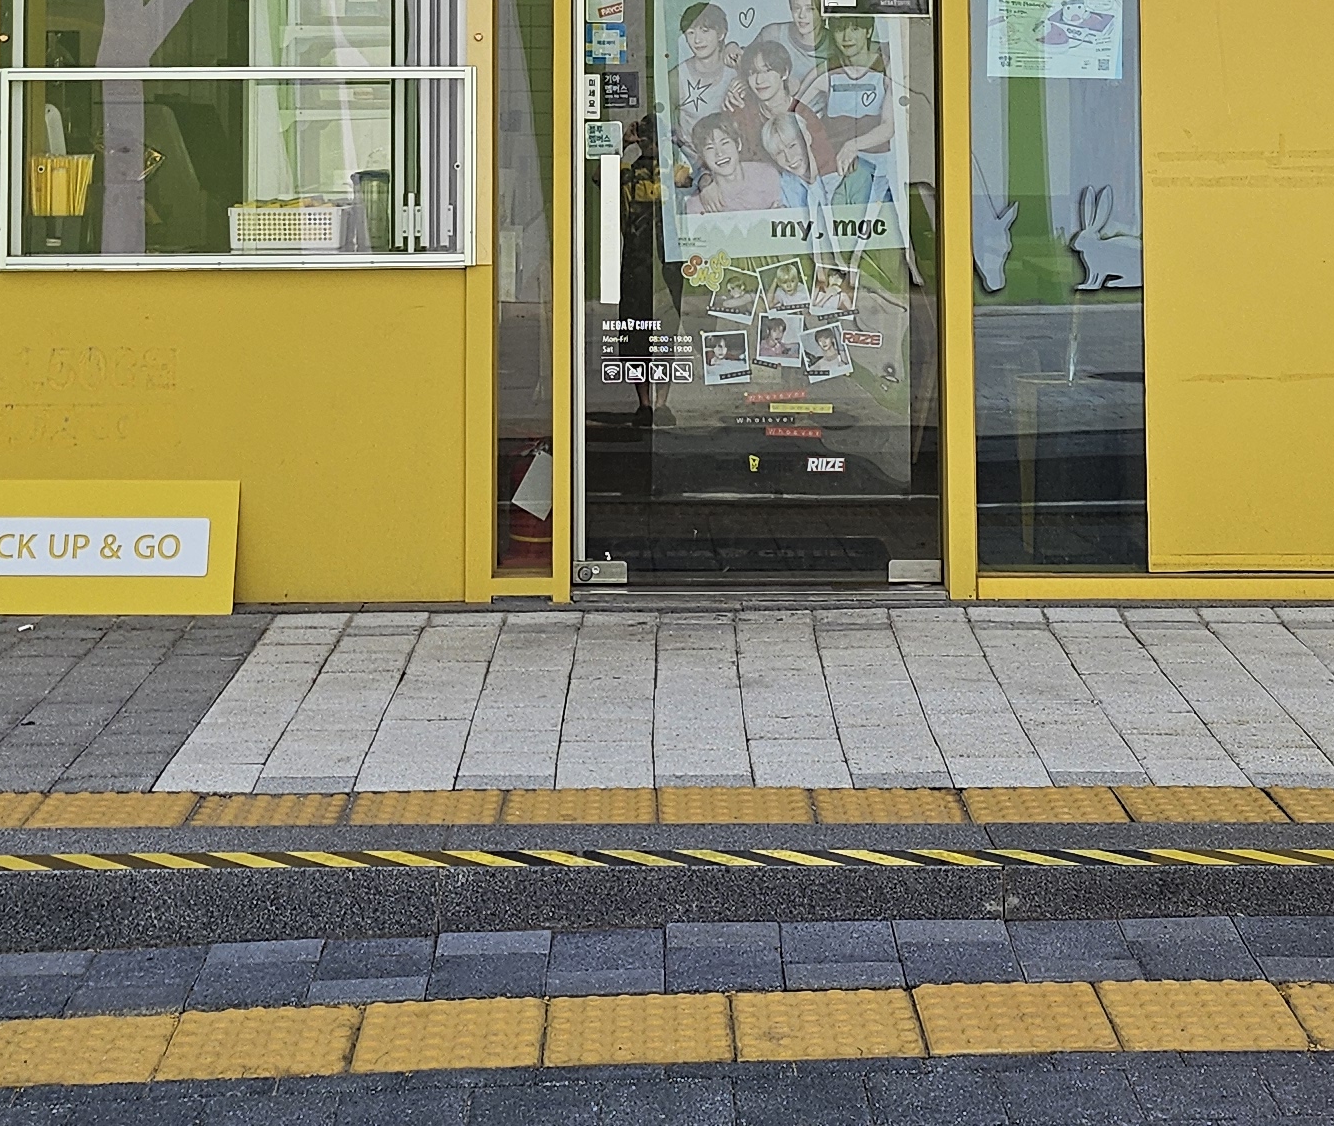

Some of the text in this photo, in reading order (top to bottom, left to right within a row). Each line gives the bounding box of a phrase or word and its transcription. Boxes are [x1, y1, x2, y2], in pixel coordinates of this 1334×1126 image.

[604, 74, 621, 84] 기아
[832, 217, 888, 241] mgc
[601, 320, 662, 331] MEGA COFFEE
[601, 335, 629, 343] Mon-Fri
[648, 335, 669, 344] 08:00
[673, 335, 693, 344] 19:00
[601, 345, 614, 354] Sat
[673, 345, 693, 353] 19:00
[806, 457, 845, 472] RIIZE
[48, 533, 91, 560] UP
[99, 534, 122, 560] &
[133, 534, 182, 560] GO
